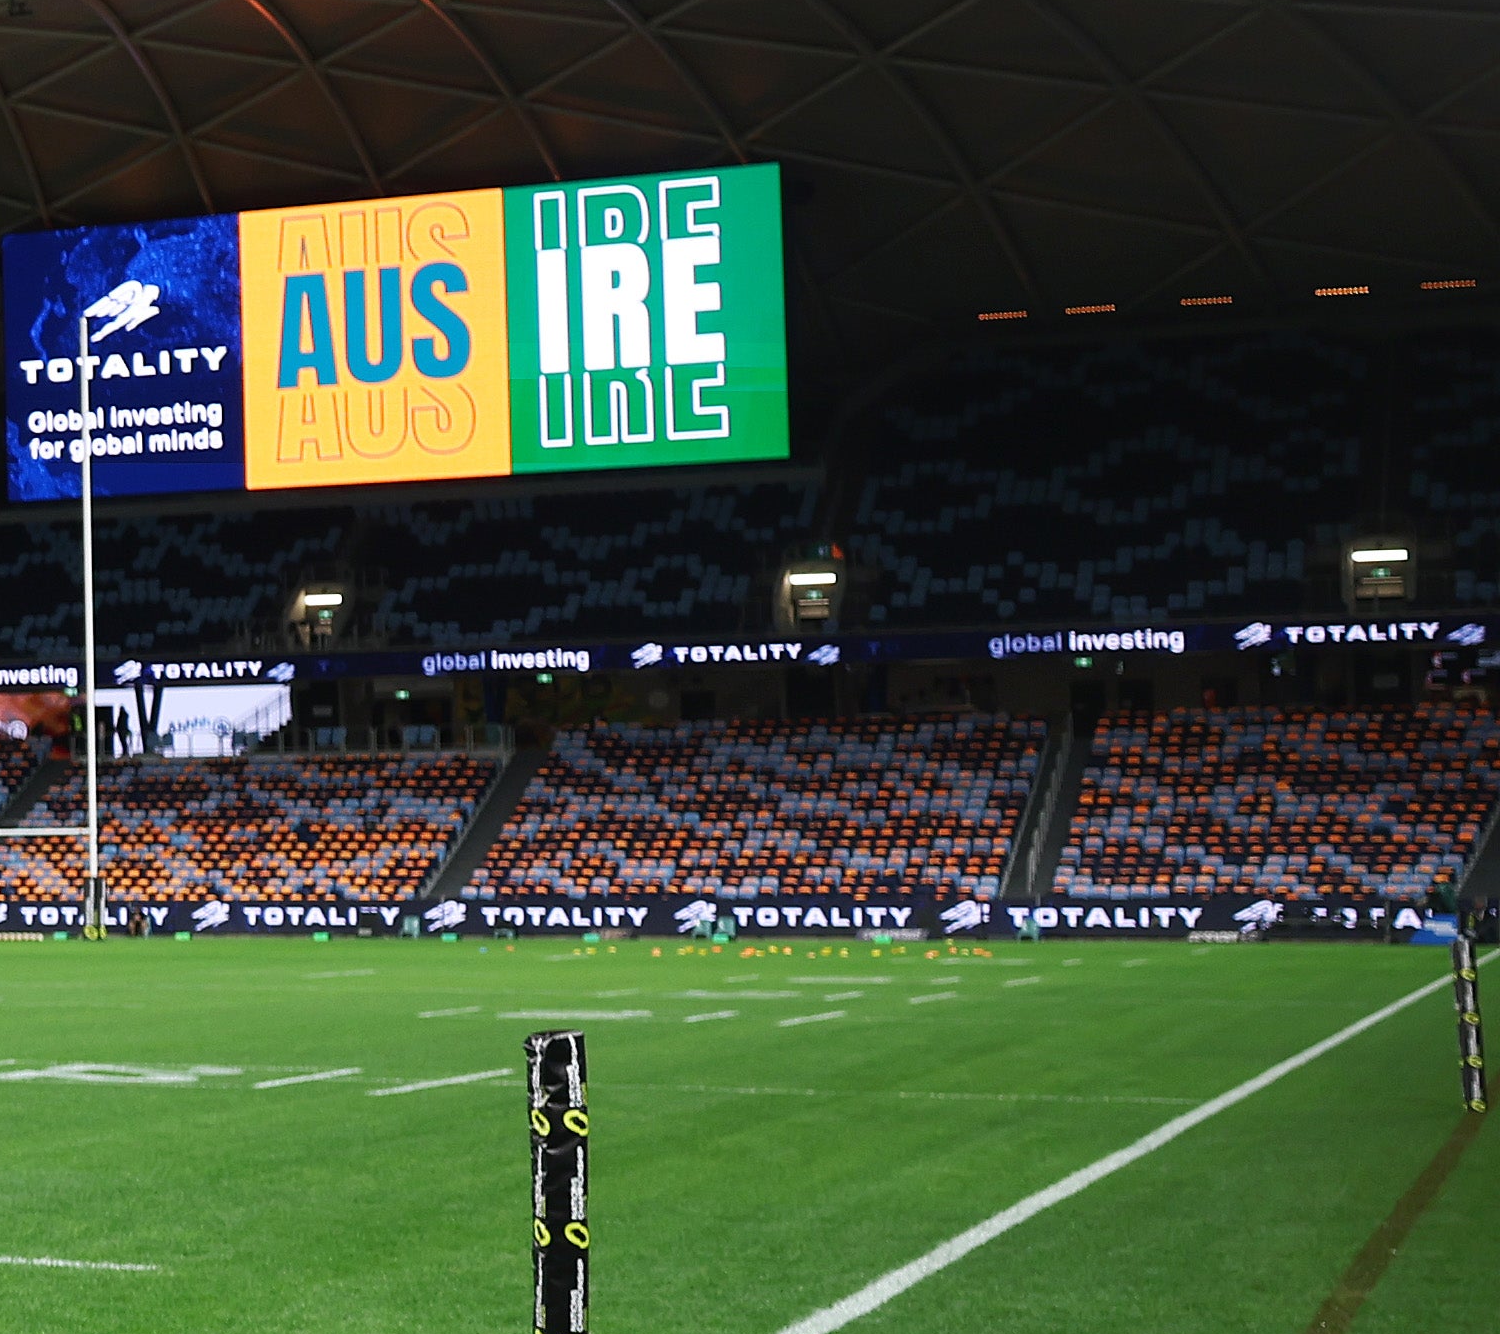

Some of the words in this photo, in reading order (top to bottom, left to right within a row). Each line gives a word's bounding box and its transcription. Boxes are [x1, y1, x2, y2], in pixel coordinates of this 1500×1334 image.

[536, 236, 725, 375] IRE
[277, 261, 471, 389] AUS
[20, 346, 228, 384] TOTALITY
[28, 406, 104, 434] Global
[110, 401, 223, 428] investing
[29, 437, 65, 460] for
[149, 427, 223, 453] minds
[988, 630, 1063, 660] global
[1068, 628, 1184, 654] investing
[1285, 621, 1440, 645] TOTALITY
[422, 652, 485, 676] global
[491, 648, 590, 672] investing
[673, 643, 802, 663] TOTALITY
[150, 661, 263, 679] TOTALITY
[20, 906, 169, 926] TOTLIY
[481, 906, 649, 927] TOTALITY
[732, 906, 912, 927] TOTALITY
[1006, 906, 1203, 929] TOTALITY
